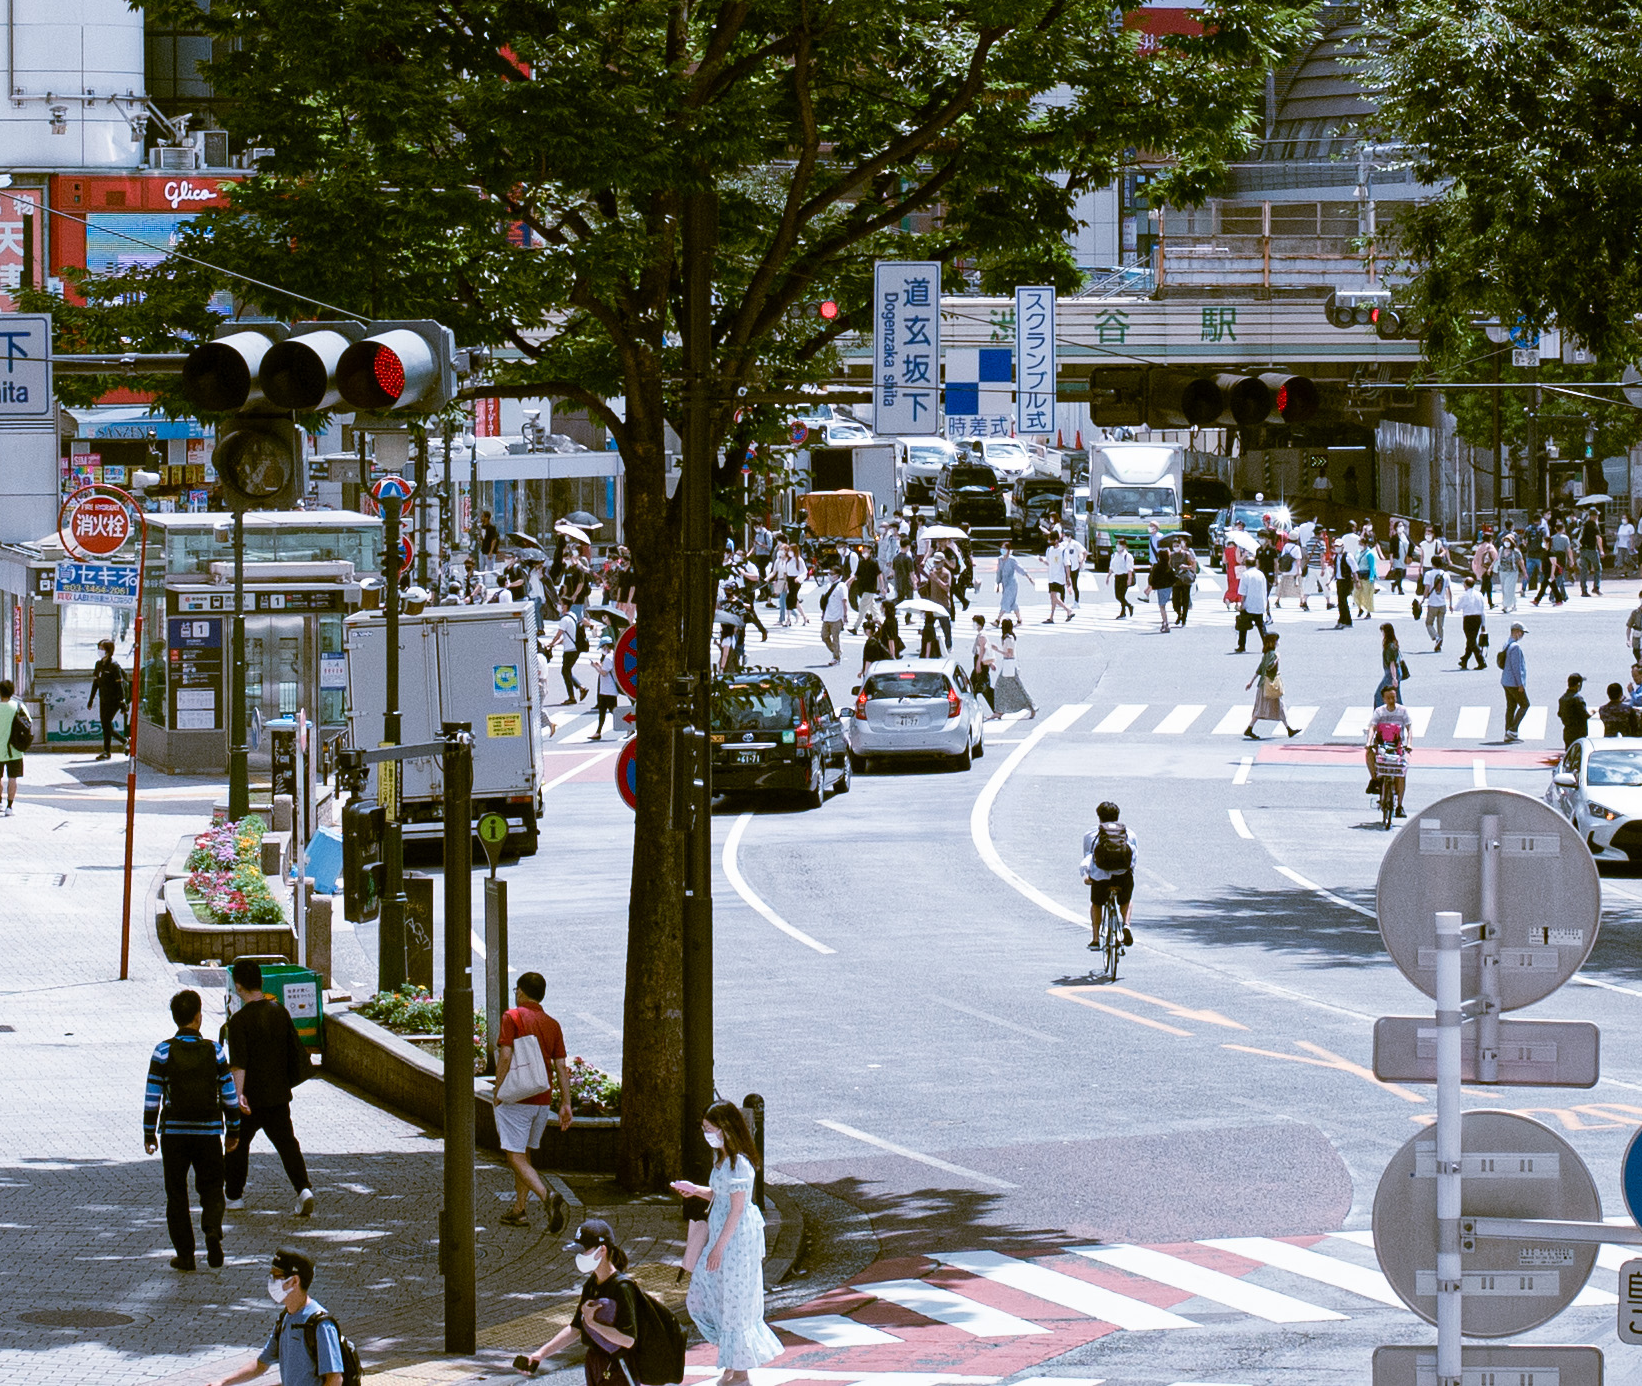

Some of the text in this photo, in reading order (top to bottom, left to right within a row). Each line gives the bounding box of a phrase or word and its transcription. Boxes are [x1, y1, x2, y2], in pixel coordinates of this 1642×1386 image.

[164, 181, 218, 209] Glico
[881, 291, 899, 407] Dogenzaka shita
[902, 277, 931, 423] 道玄坂下
[1025, 292, 1048, 430] スクランブル式
[948, 416, 1009, 437] 時差式
[76, 514, 125, 537] 消火栓
